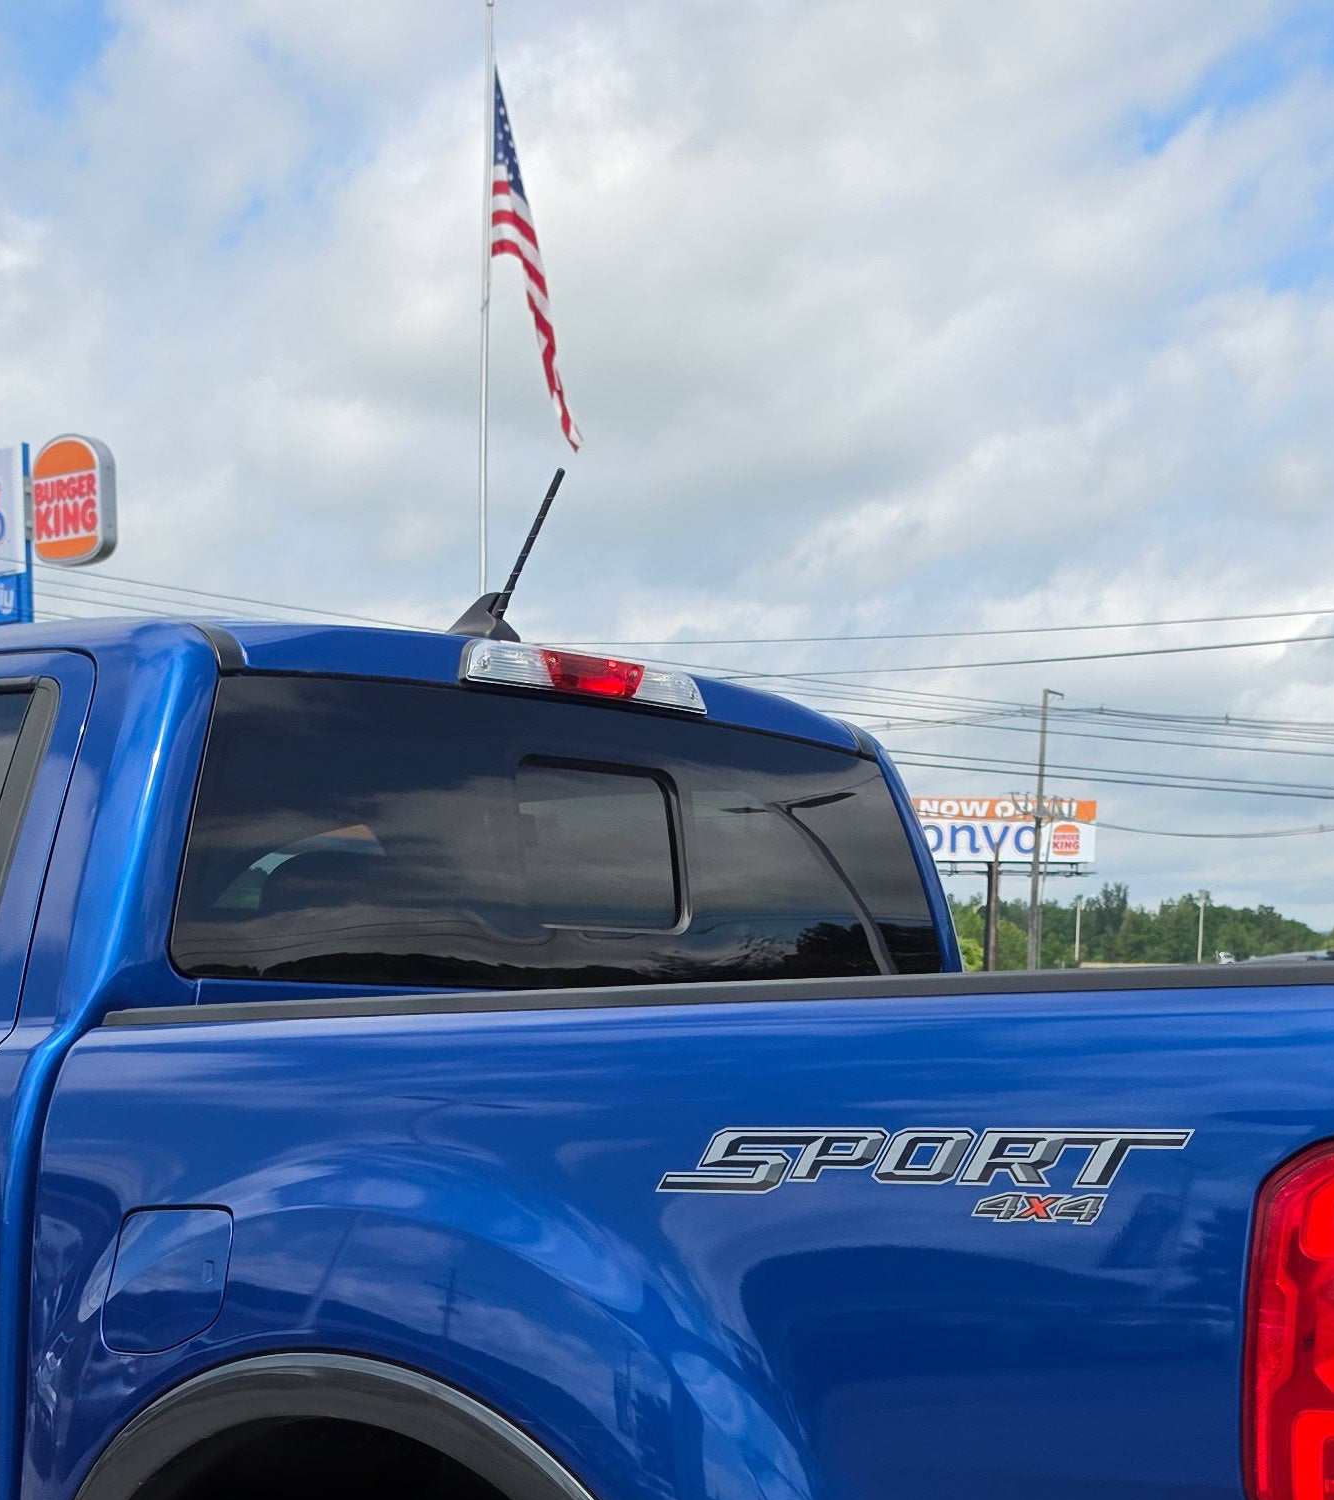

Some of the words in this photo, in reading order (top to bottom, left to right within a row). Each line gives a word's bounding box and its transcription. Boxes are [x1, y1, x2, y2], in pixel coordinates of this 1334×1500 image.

[34, 472, 97, 507] BURGER
[35, 498, 98, 541] KING
[918, 799, 990, 818] NOW
[1052, 841, 1080, 850] KING
[655, 1127, 1195, 1194] SPORT
